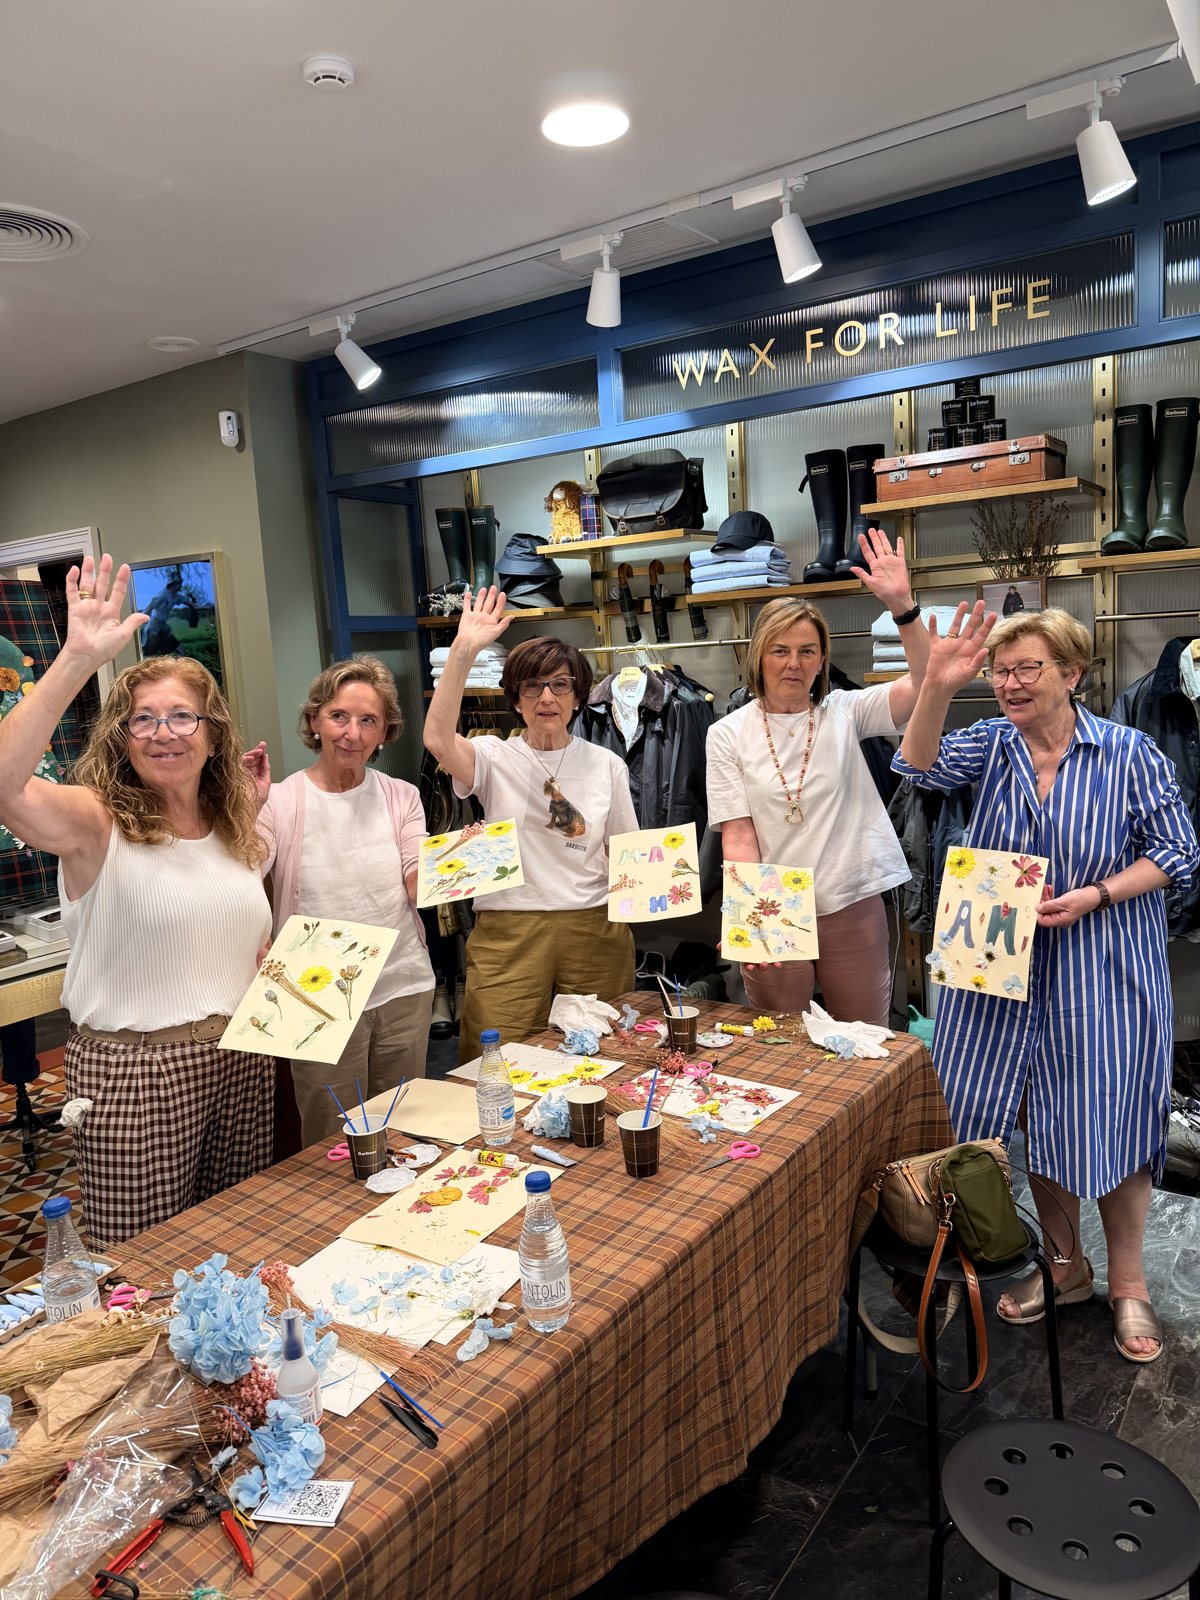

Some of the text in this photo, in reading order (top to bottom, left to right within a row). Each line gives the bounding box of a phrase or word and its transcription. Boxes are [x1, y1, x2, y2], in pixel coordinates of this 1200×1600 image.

[673, 278, 1051, 391] WAX FOR LIFE
